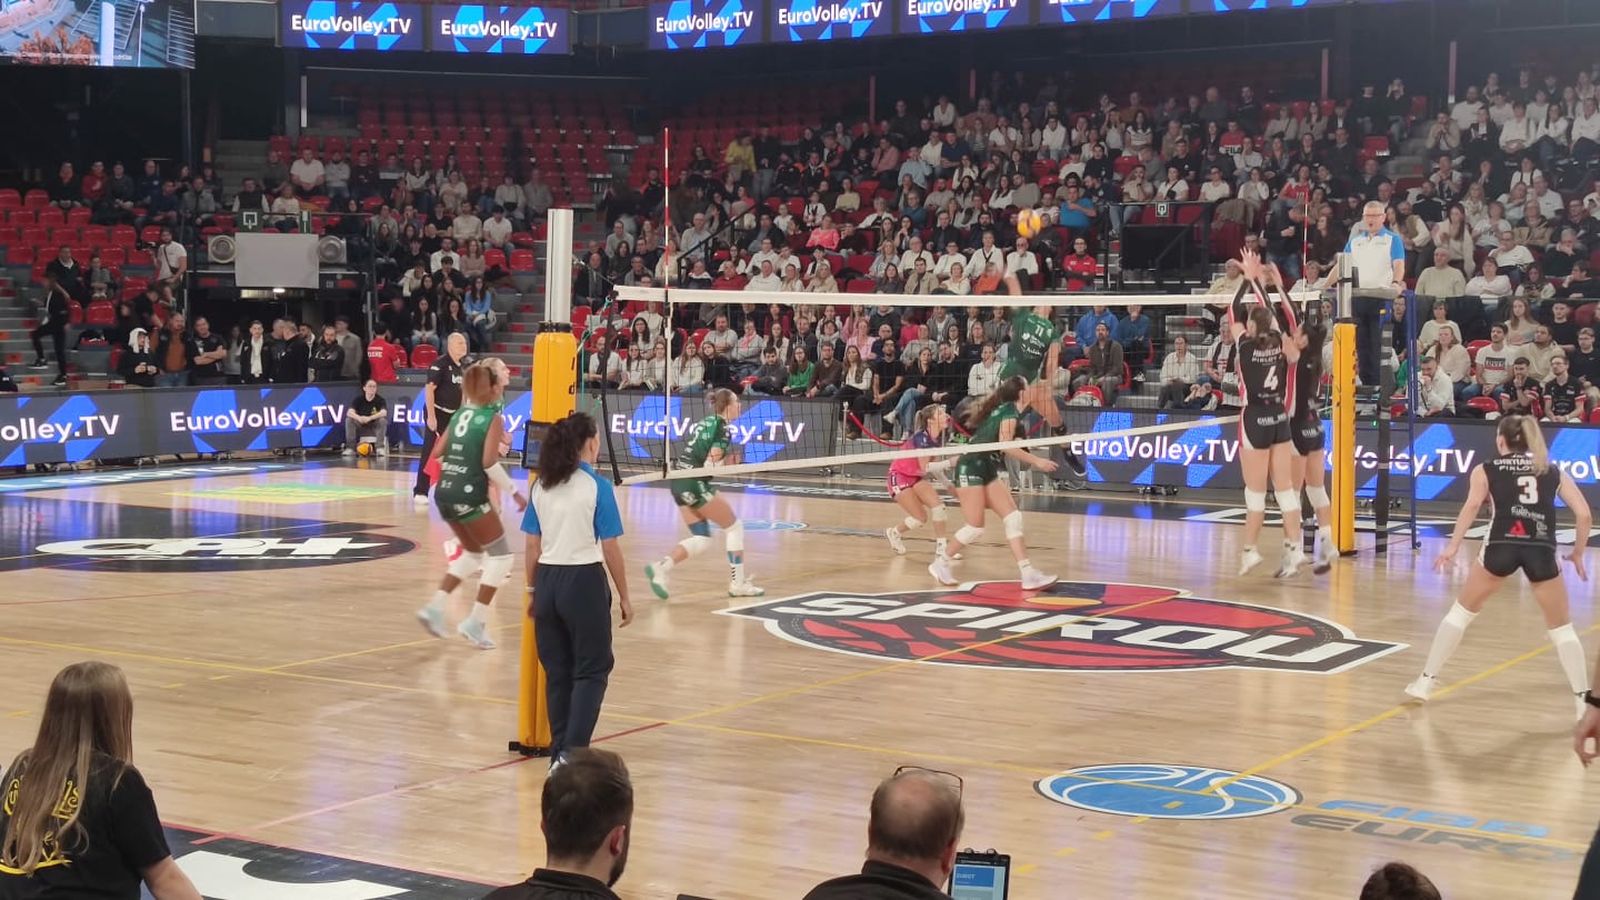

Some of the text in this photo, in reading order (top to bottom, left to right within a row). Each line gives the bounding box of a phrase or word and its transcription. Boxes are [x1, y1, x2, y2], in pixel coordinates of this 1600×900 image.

[291, 14, 411, 36] EuroVolley.TV
[656, 11, 753, 33] EuroVolley.TV
[779, 1, 883, 25] EuroVolley.TV
[441, 19, 558, 40] EuroVolley.TV
[1263, 365, 1279, 391] 4
[171, 404, 345, 432] EuroVolley.TV
[454, 410, 475, 438] 8
[1517, 475, 1539, 505] 3
[770, 597, 1362, 663] SPIROU
